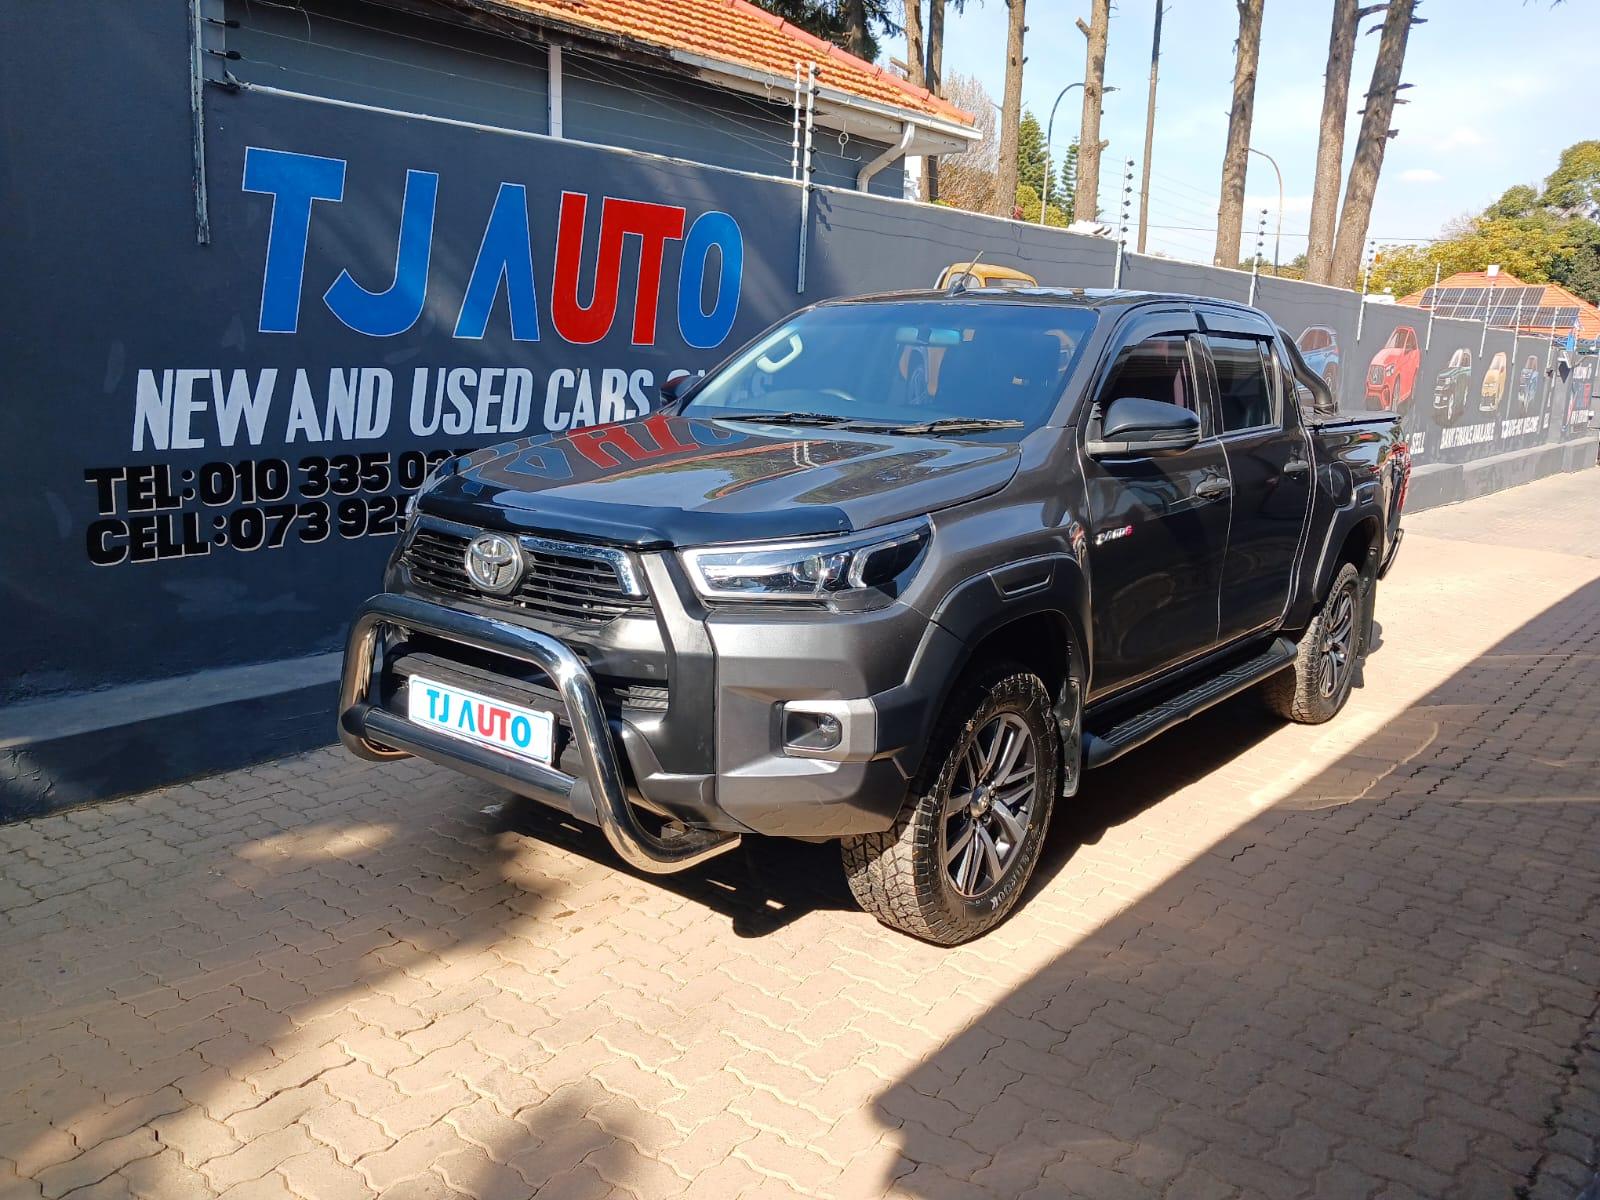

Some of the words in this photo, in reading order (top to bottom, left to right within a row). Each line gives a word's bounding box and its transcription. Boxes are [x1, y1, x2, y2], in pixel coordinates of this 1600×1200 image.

[242, 147, 439, 337] TJ
[453, 182, 744, 349] AUTO
[132, 368, 278, 452] NEW
[285, 367, 393, 444] AND
[408, 366, 533, 436] USED
[543, 367, 654, 432] CARS
[298, 451, 392, 500] 335
[426, 689, 449, 723] TJ
[458, 700, 532, 748] AUTO
